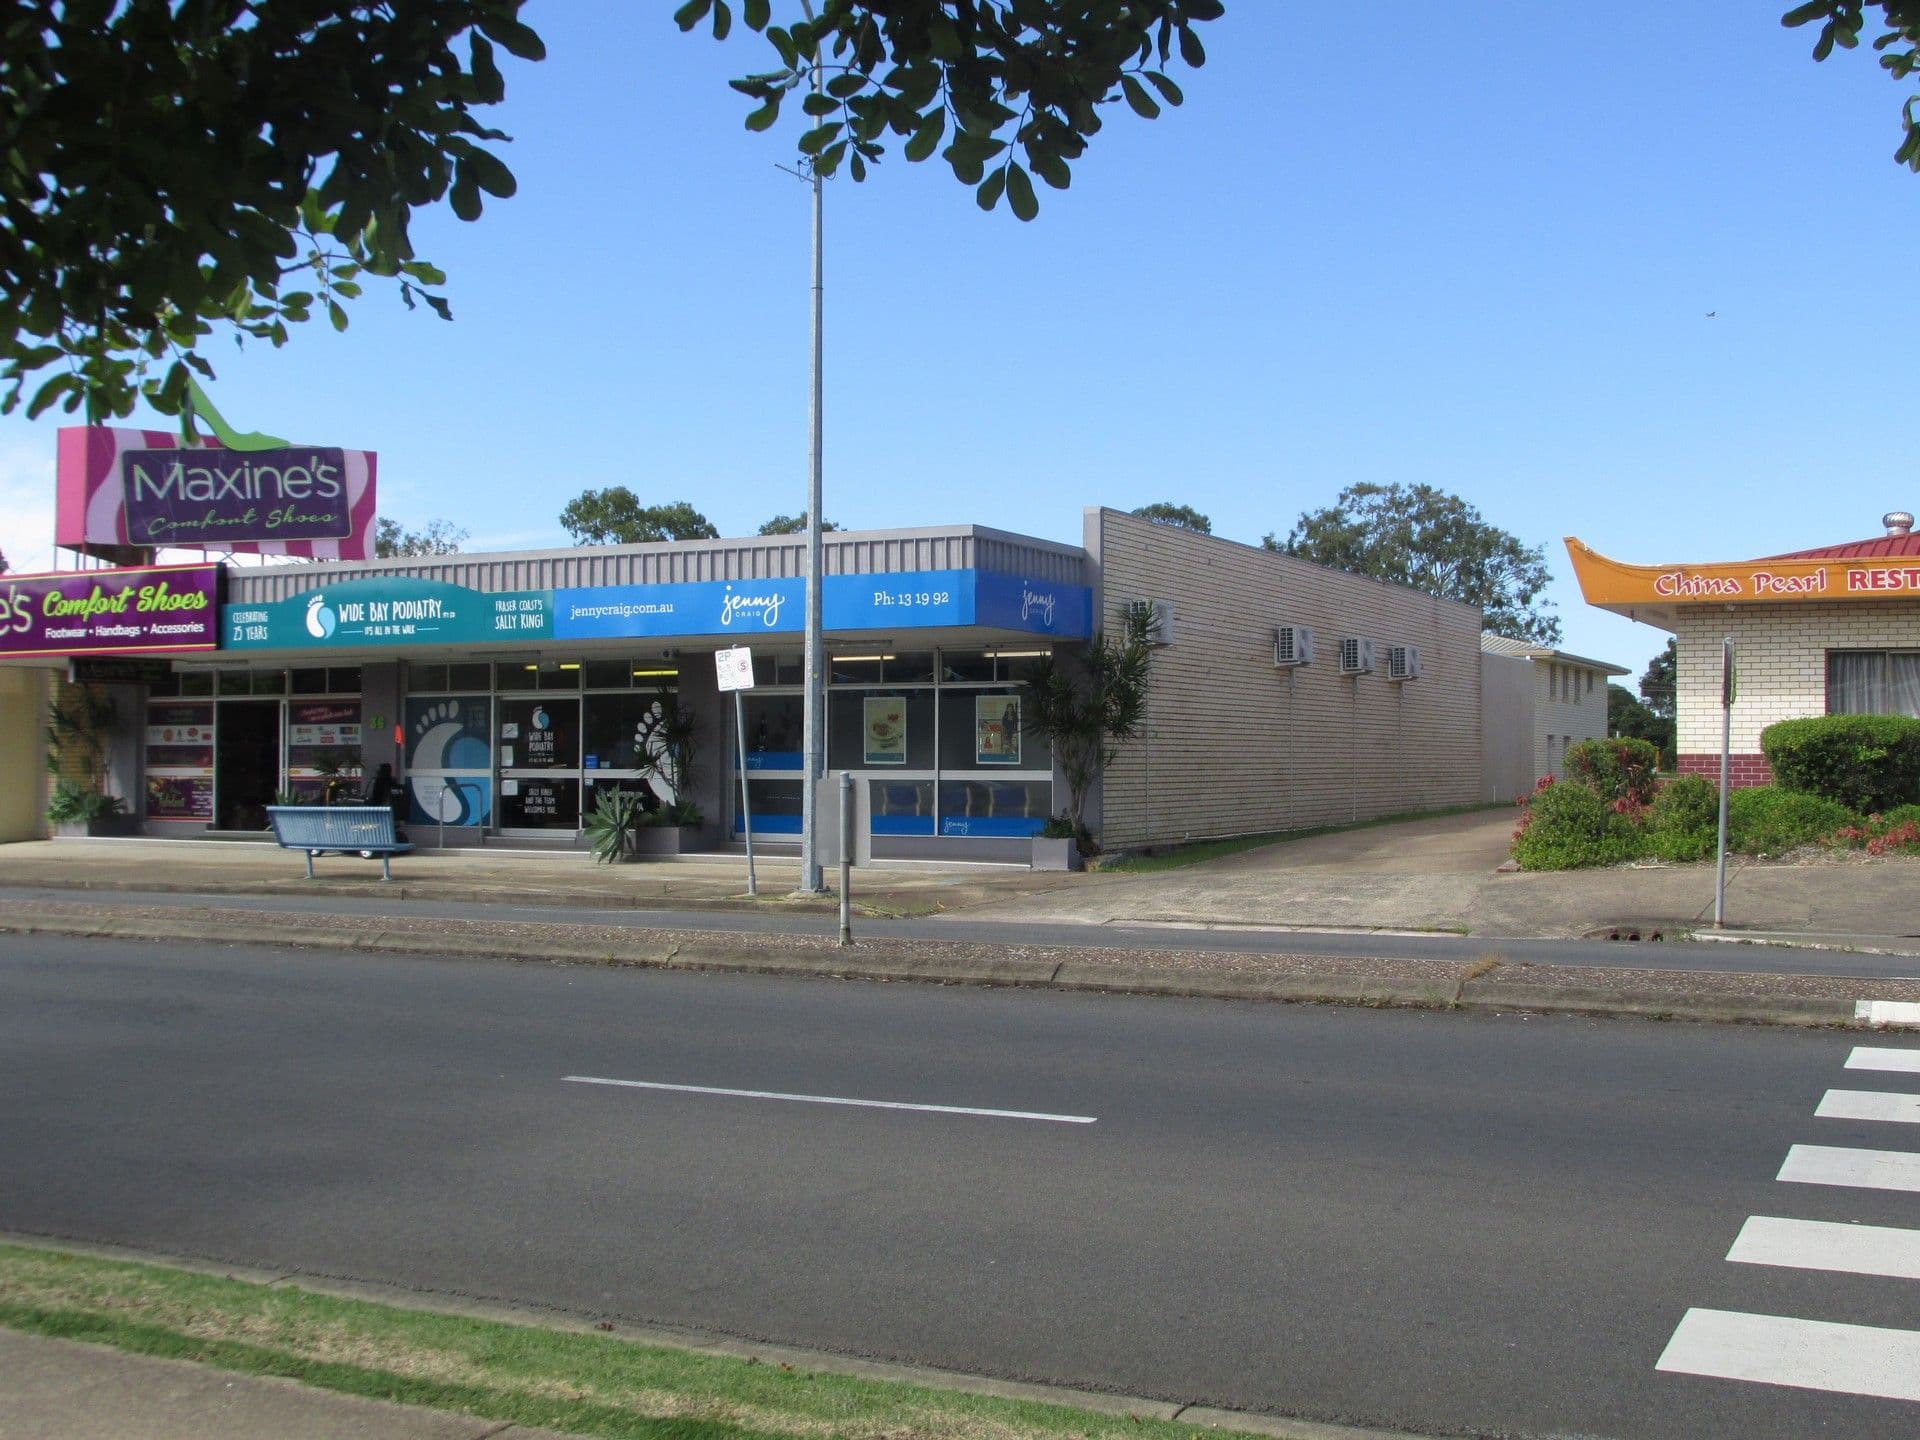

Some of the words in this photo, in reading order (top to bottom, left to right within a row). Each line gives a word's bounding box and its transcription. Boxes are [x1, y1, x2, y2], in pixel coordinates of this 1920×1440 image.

[133, 456, 341, 501] Maxine's
[147, 508, 257, 536] Comfort
[265, 504, 337, 529] Shoes
[1654, 572, 1743, 597] China
[1752, 567, 1827, 595] Pearl
[42, 585, 135, 622] Comfort
[136, 581, 208, 613] Shoes
[495, 600, 517, 612] FRASER
[721, 585, 785, 627] jenny
[873, 590, 895, 606] Ph:
[898, 593, 912, 607] 13
[915, 592, 929, 606] 19
[933, 592, 949, 606] 92
[1021, 580, 1056, 626] jenny
[232, 610, 269, 625] CELEBRATING
[338, 603, 365, 623] WIDE
[369, 602, 388, 622] BAY
[392, 598, 442, 622] PODIATRY
[570, 602, 674, 621] jennycraig.com.au
[735, 610, 761, 618] CRAIG
[45, 627, 87, 639] Footwear
[95, 624, 141, 638] Handbags
[150, 621, 205, 635] Accessories
[494, 614, 517, 631] SALLY
[246, 626, 268, 641] YEARS
